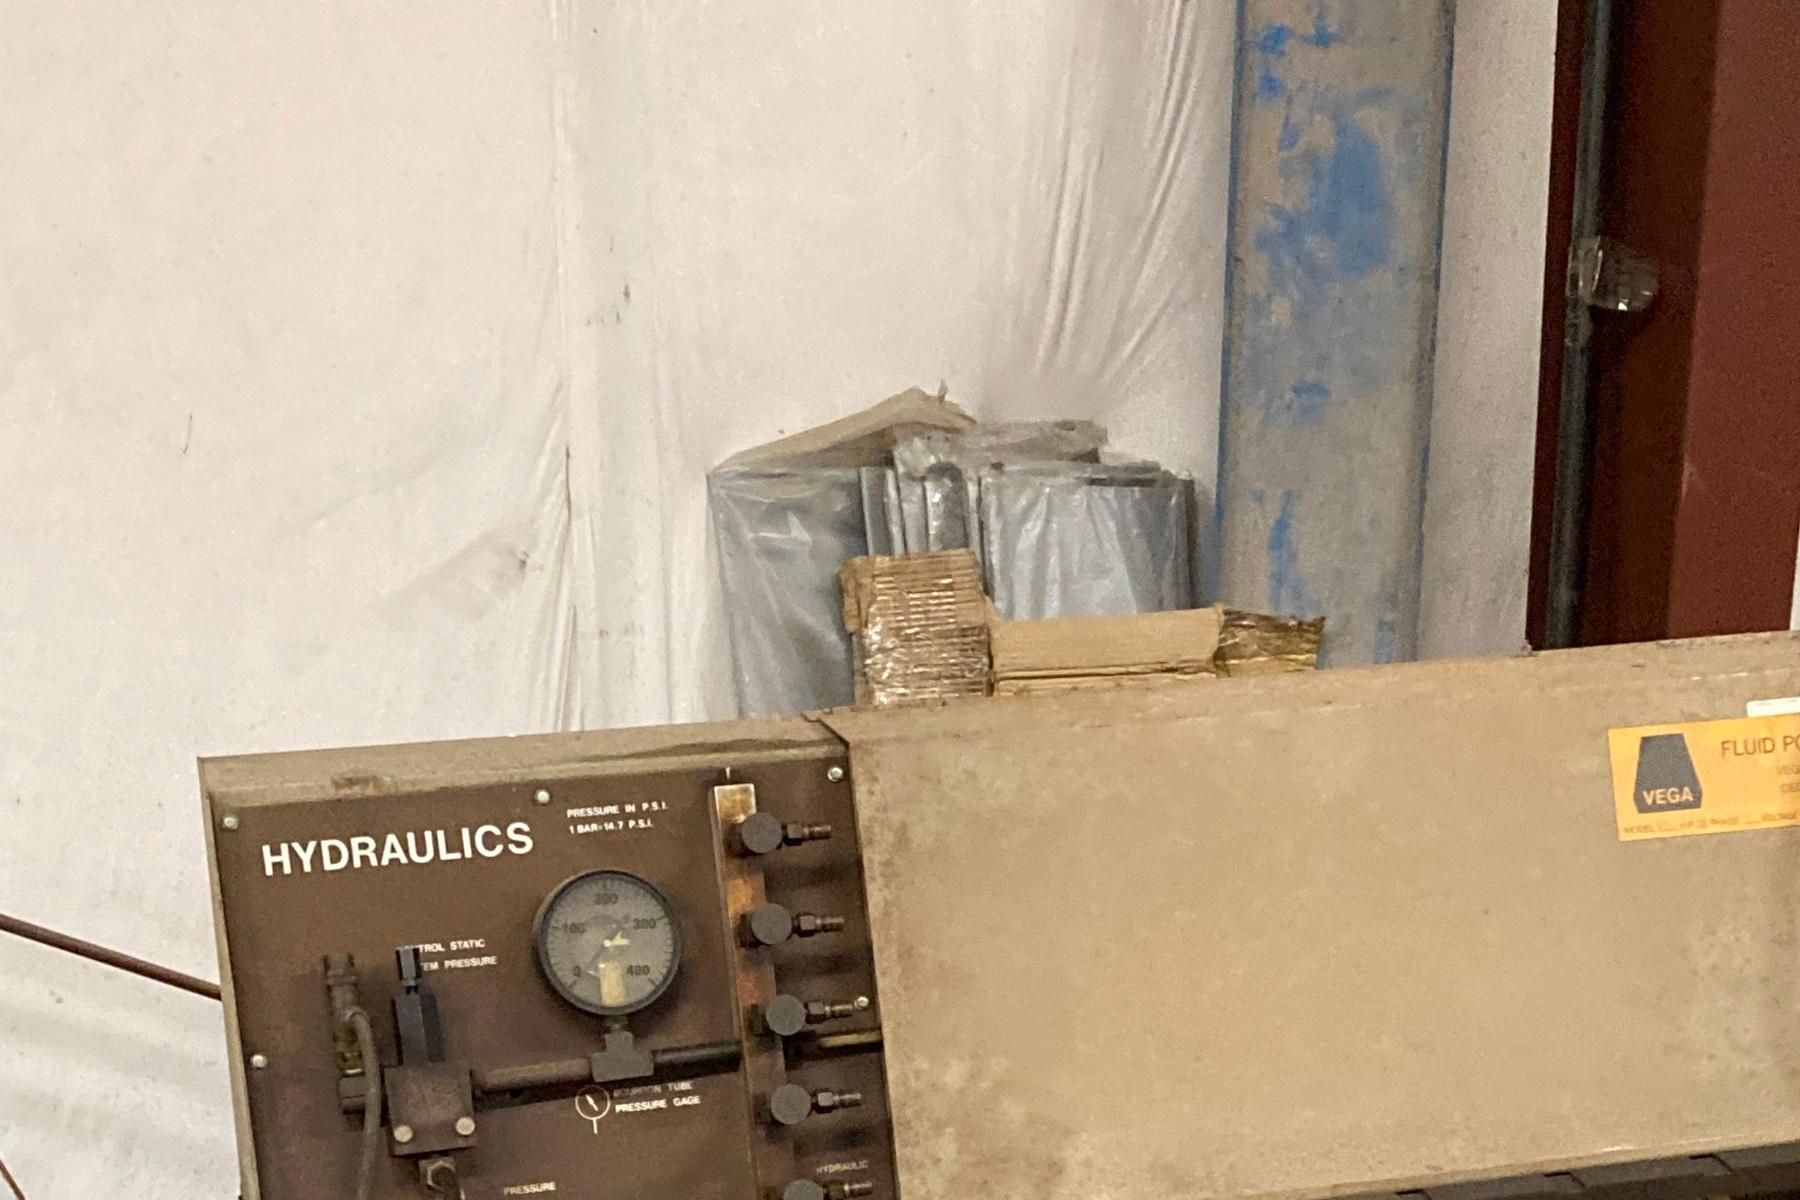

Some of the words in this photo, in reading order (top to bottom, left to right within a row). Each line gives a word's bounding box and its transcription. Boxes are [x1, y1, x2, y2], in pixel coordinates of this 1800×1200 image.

[1721, 736, 1776, 757] FLUID
[1642, 786, 1695, 806] VEGA
[567, 804, 620, 818] PRESSURE
[625, 803, 636, 813] IN
[569, 824, 575, 835] 1
[262, 821, 534, 876] HYDRAULICS
[450, 939, 486, 951] STATIC
[444, 956, 498, 969] PRESSURE
[615, 1098, 668, 1113] PRESSURE
[673, 1095, 700, 1107] GAGE
[504, 1181, 556, 1195] PRESSURE
